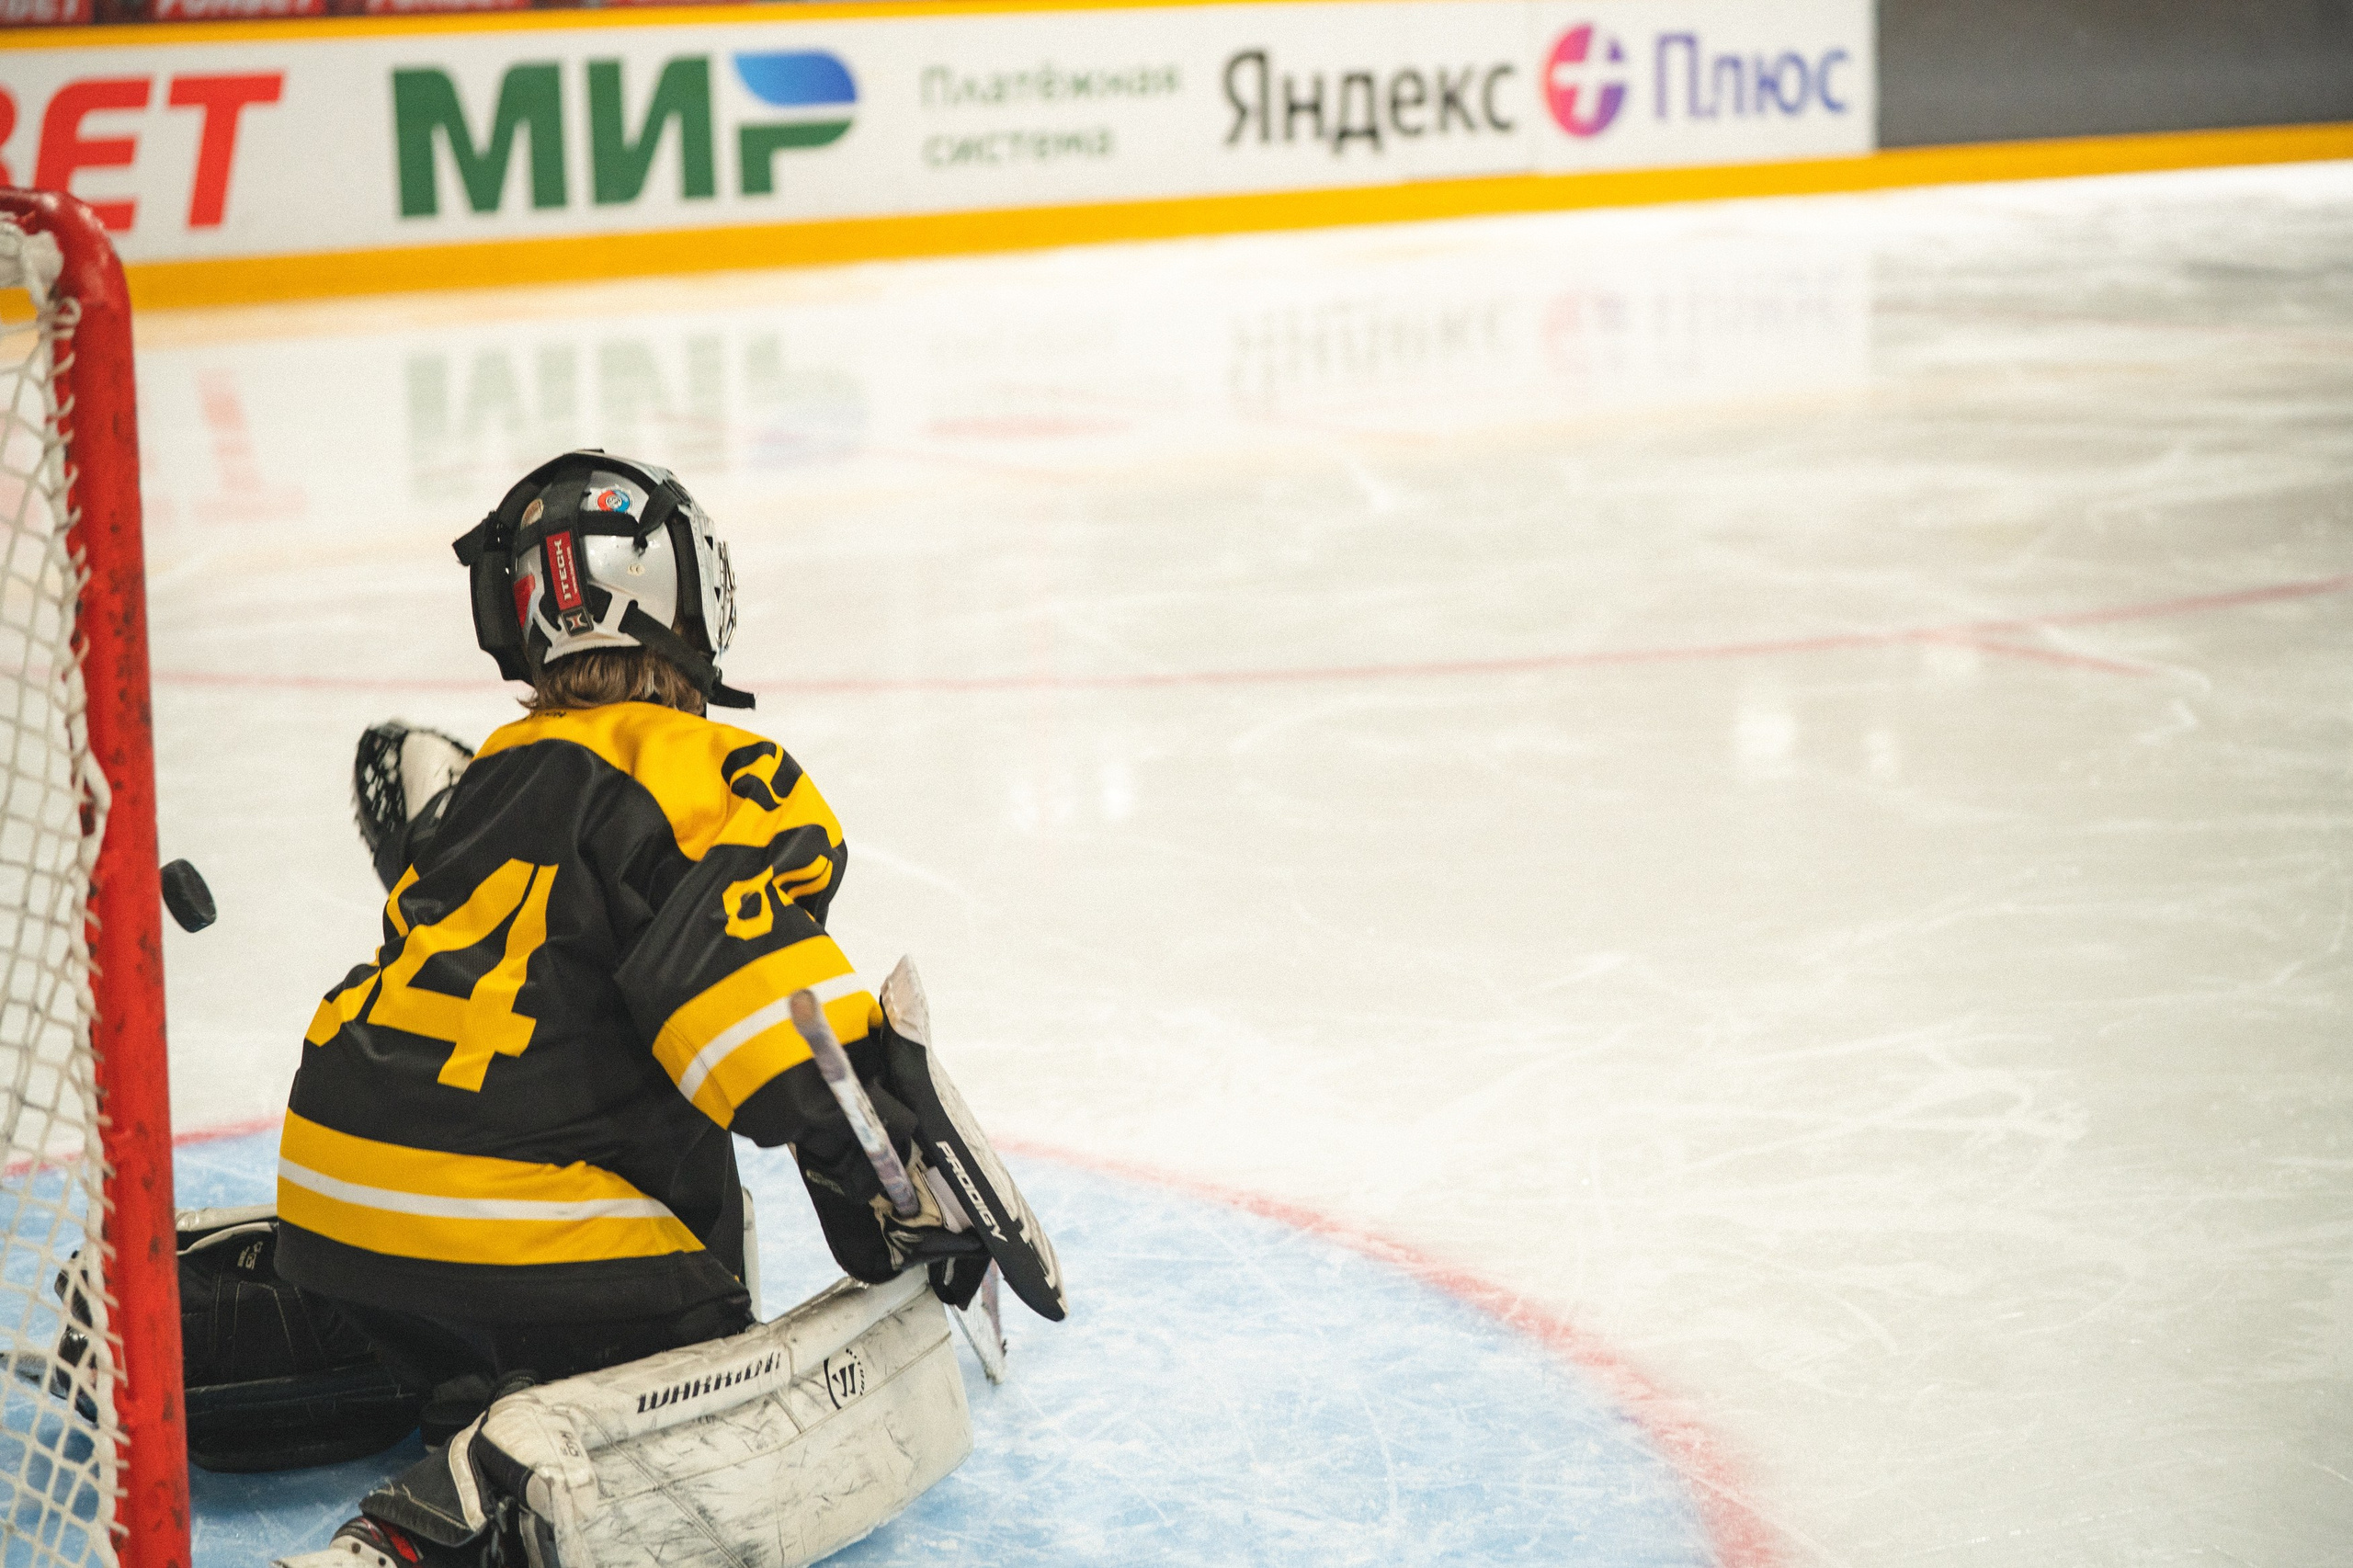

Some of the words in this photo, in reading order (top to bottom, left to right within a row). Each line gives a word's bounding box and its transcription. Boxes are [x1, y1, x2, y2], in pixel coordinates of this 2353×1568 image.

[0, 72, 284, 233] ET
[392, 49, 859, 217] МИР
[1223, 46, 1517, 156] Яндекс
[1654, 31, 1849, 119] Плюс
[553, 539, 572, 601] ITECH
[936, 1141, 1008, 1243] PRODIGY
